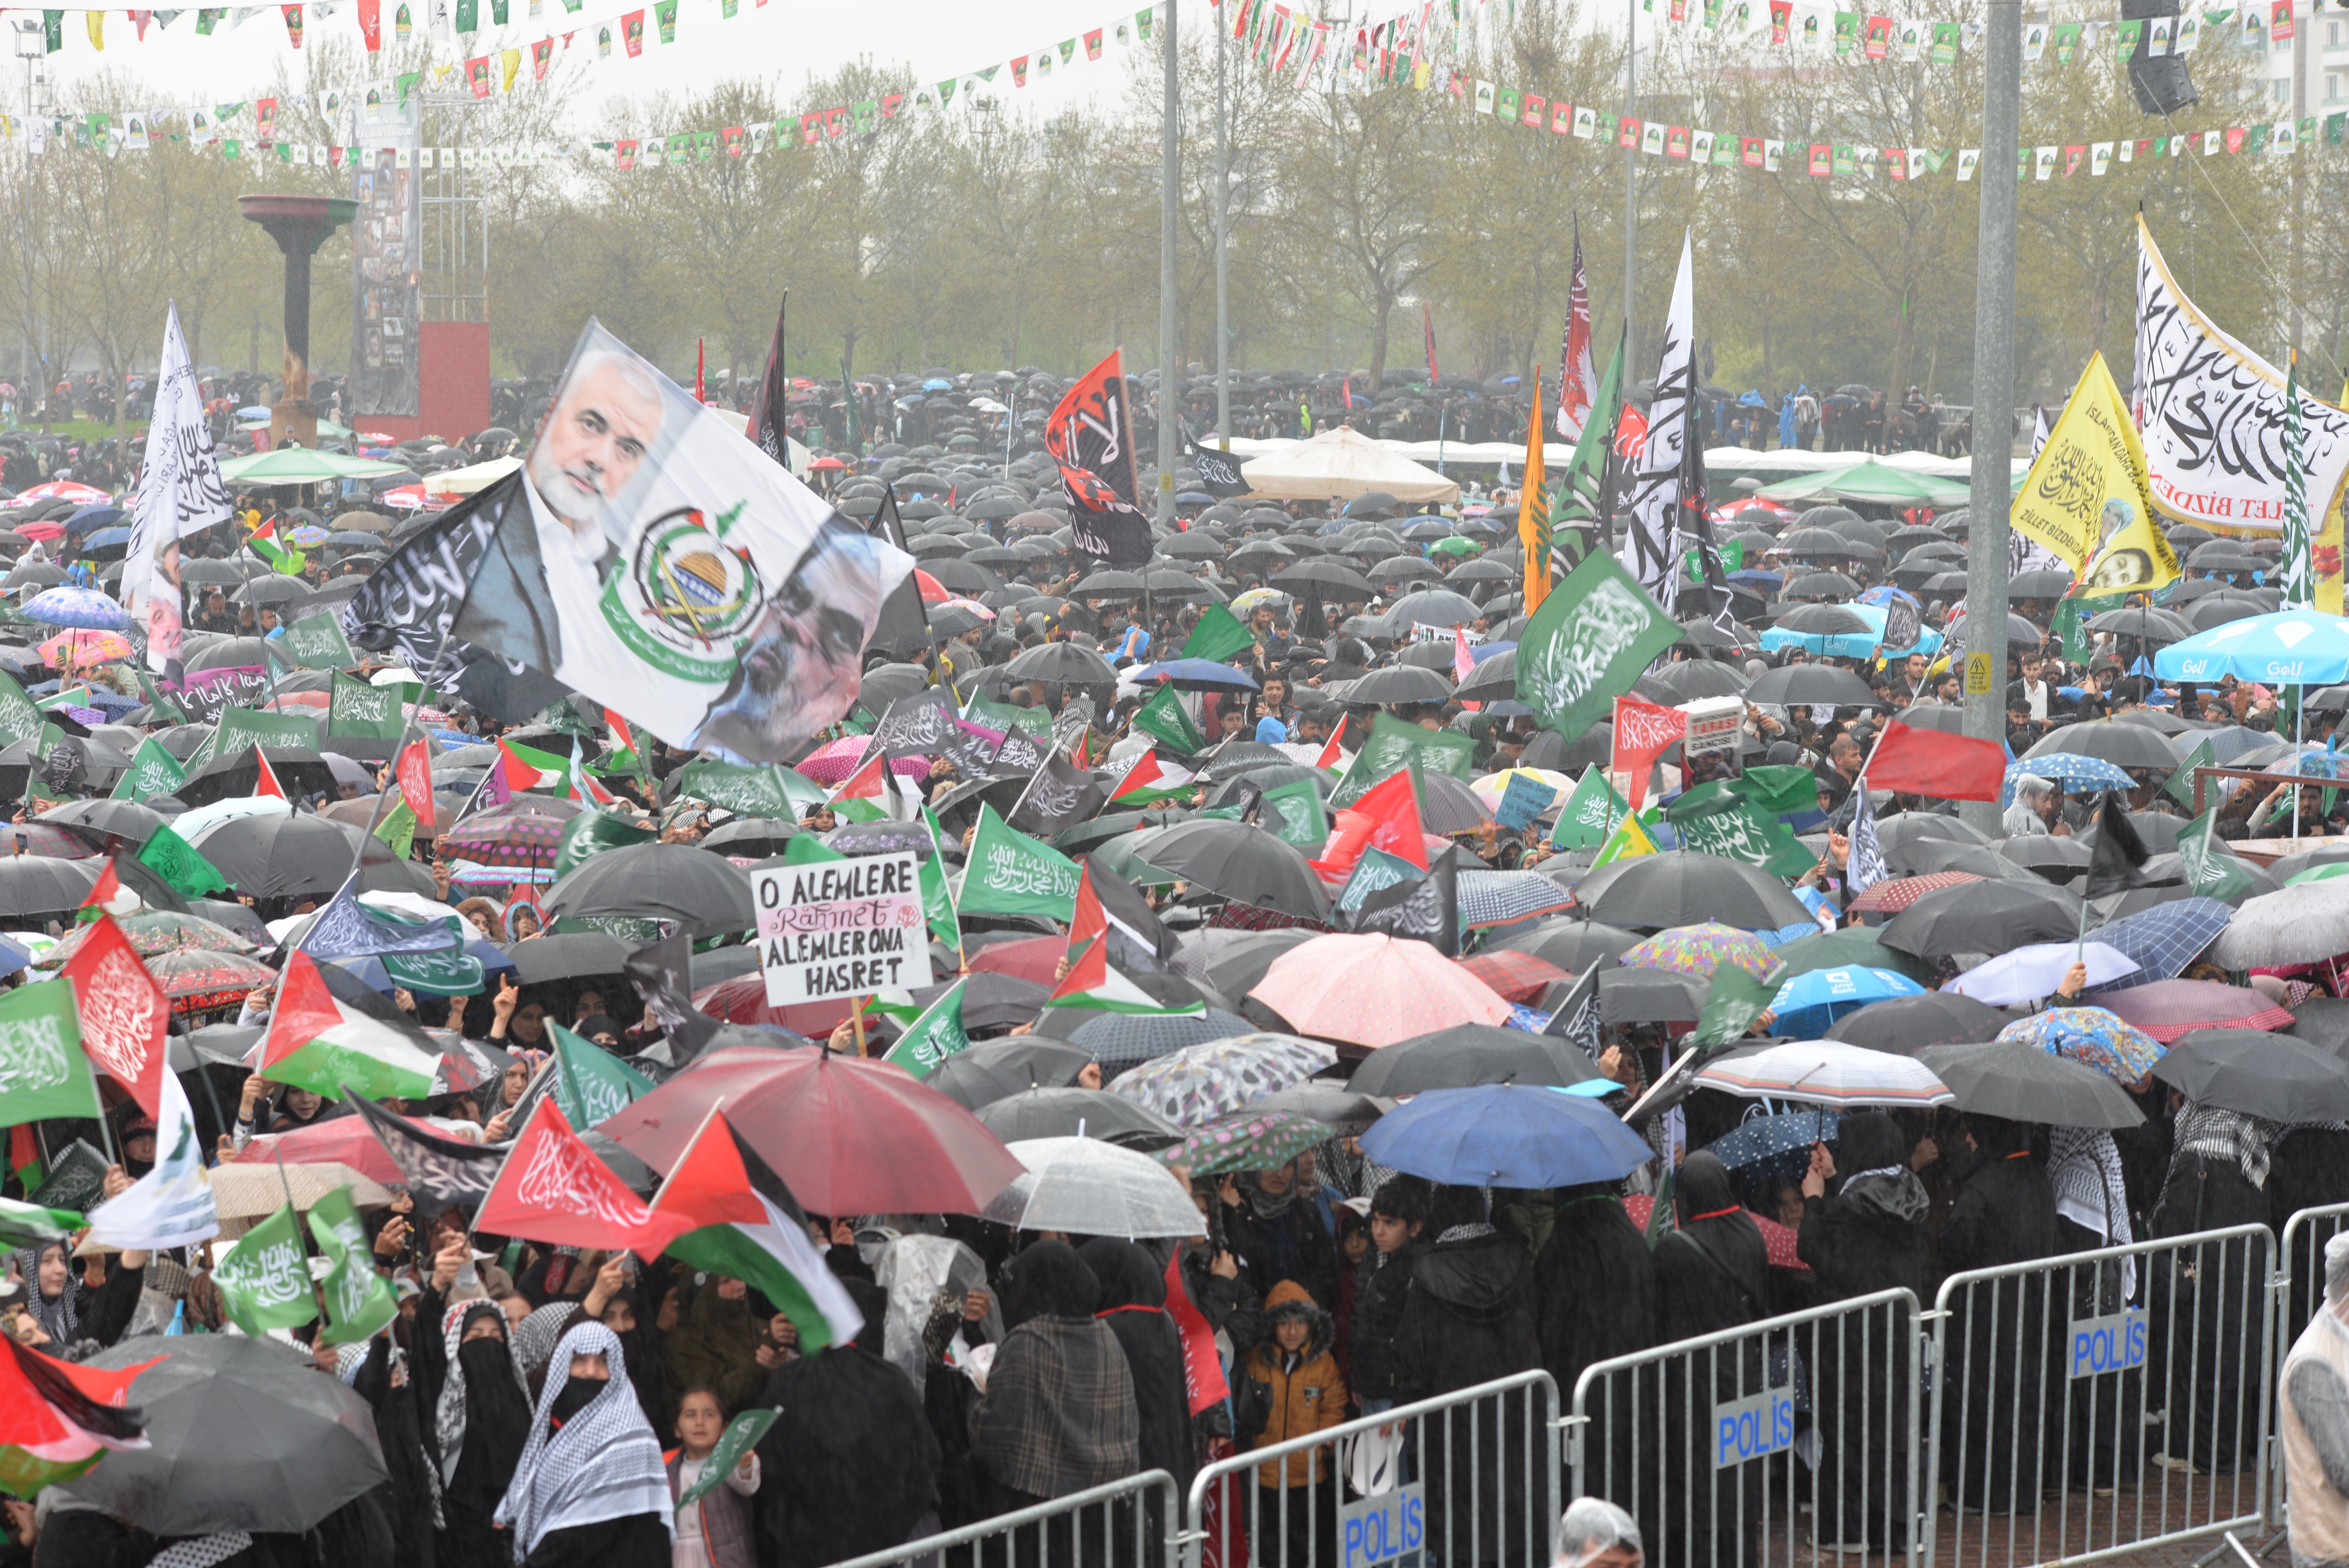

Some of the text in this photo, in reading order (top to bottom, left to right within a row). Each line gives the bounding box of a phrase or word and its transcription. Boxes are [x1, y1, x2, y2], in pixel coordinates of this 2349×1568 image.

[2019, 508, 2050, 532] ZİLLET
[2183, 659, 2304, 677] Golf Golf
[760, 860, 913, 908] O ALEMLERE
[766, 927, 905, 968] ALEMLER ONA
[805, 957, 903, 996] HASRET
[2073, 1316, 2145, 1376] POLİS
[1719, 1394, 1793, 1465] POLİS
[1345, 1492, 1423, 1568] POLİS
